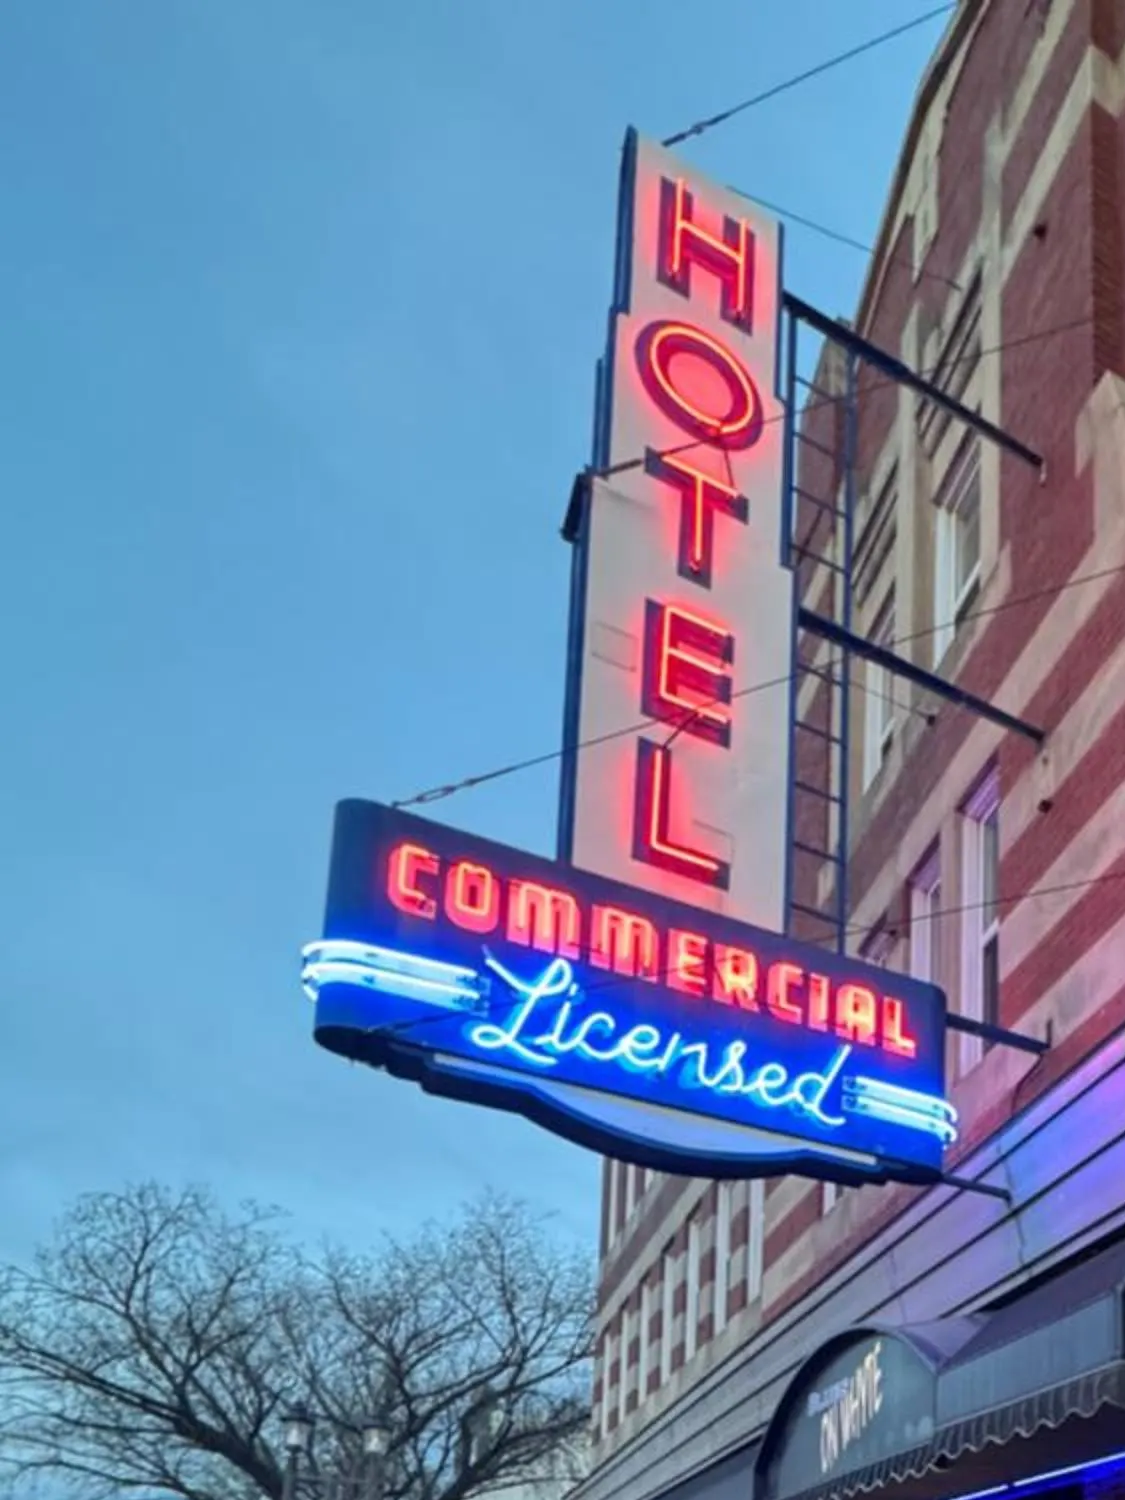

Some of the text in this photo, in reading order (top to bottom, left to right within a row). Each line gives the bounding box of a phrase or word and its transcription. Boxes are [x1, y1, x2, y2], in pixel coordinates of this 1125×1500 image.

[631, 173, 764, 890] HOTEL
[387, 842, 916, 1059] COMMERCIAL
[470, 946, 854, 1127] Licensed
